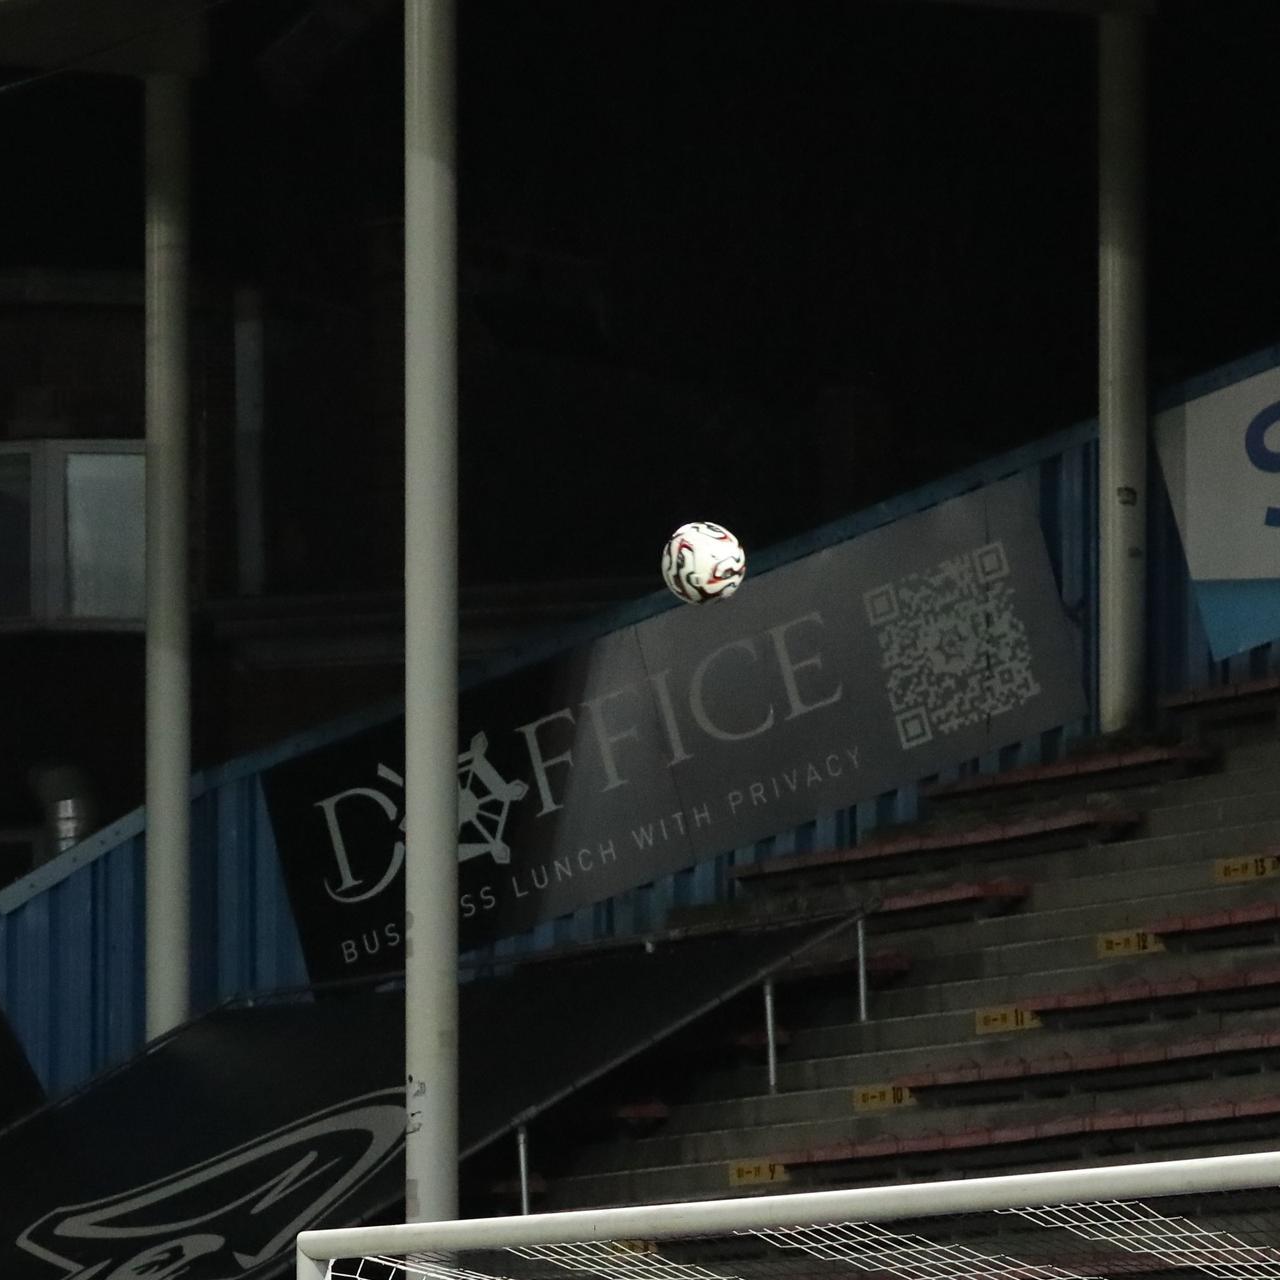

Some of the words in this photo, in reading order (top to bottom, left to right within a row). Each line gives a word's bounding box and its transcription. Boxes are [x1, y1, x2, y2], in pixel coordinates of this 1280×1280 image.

[341, 886, 497, 963] BUSSS
[511, 840, 618, 899] LUNCH
[631, 802, 711, 852] WITH
[727, 746, 863, 815] PRIVACY
